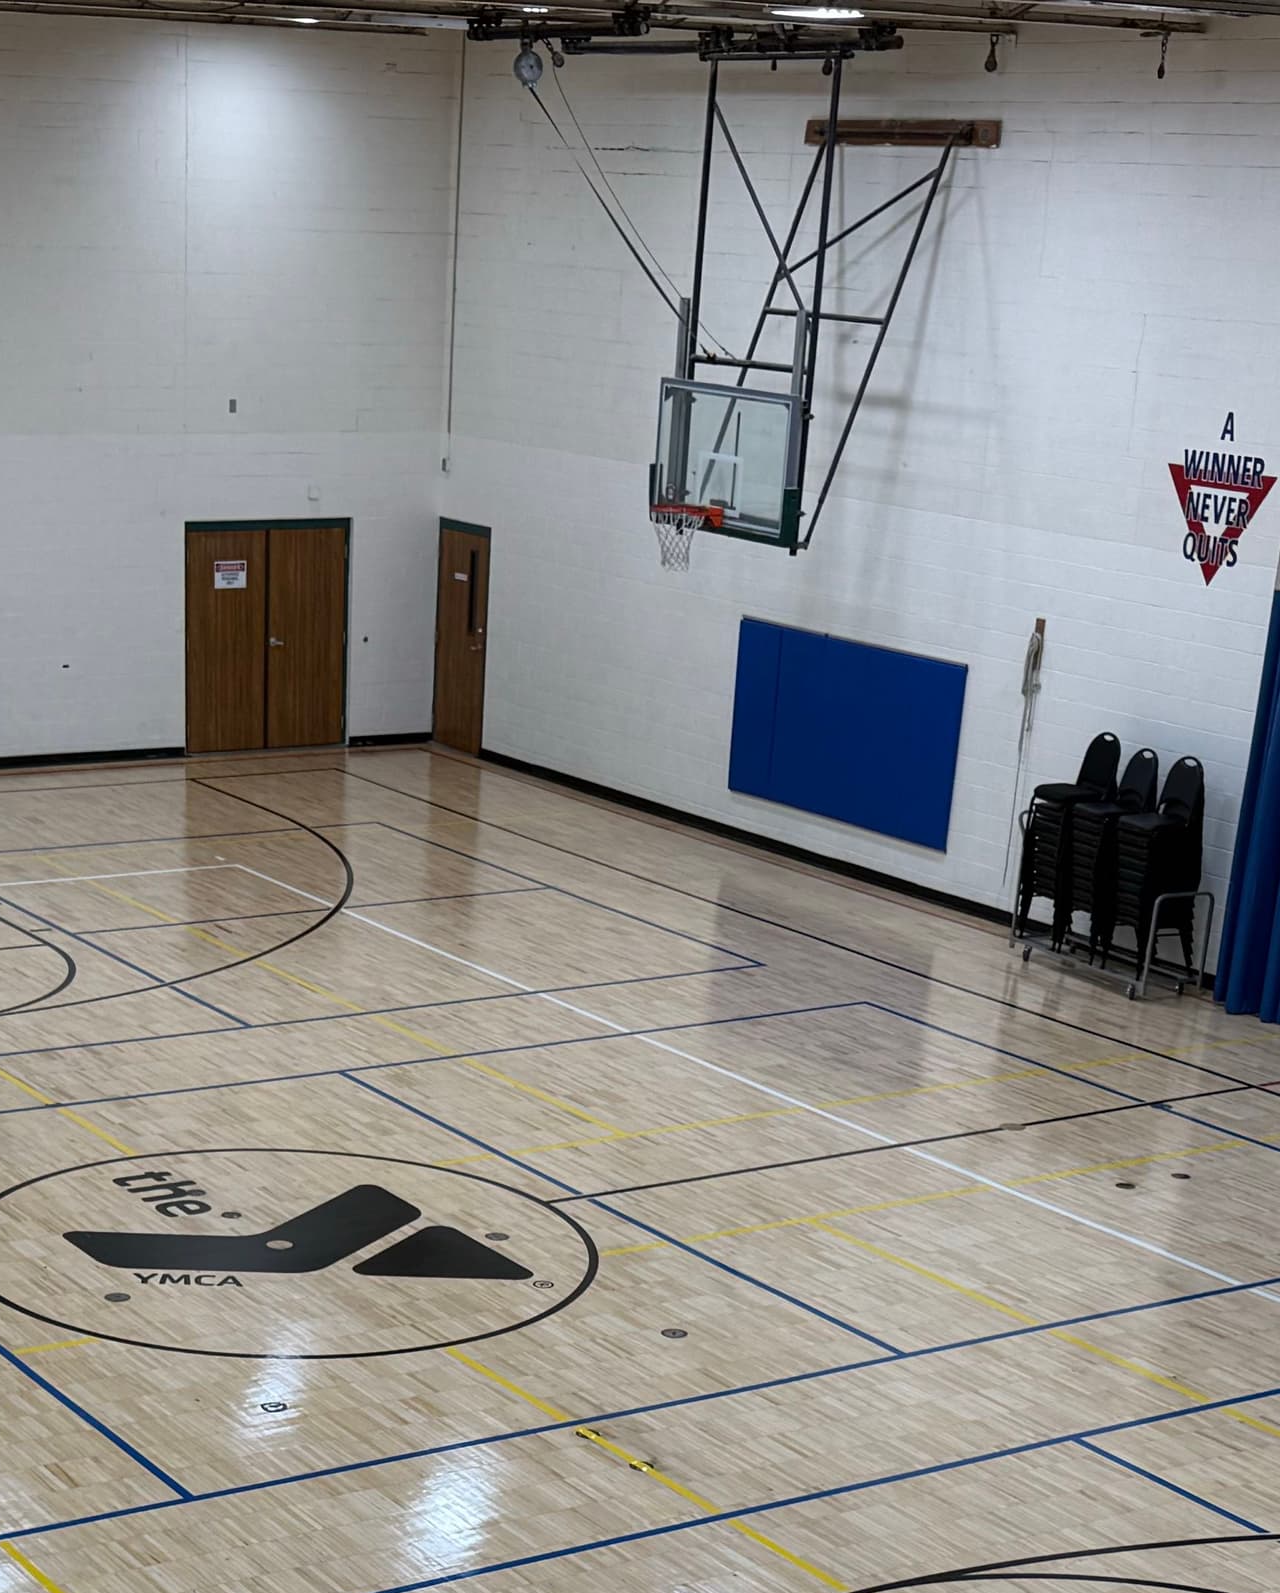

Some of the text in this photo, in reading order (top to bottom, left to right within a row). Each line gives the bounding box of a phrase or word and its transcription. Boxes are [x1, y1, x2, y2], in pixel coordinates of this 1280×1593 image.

[1220, 411, 1235, 442] A
[1184, 449, 1266, 488] WINNER
[1186, 490, 1250, 529] NEVER
[1182, 532, 1239, 568] QUITS
[112, 1171, 212, 1218] the
[133, 1272, 244, 1287] YMCA
